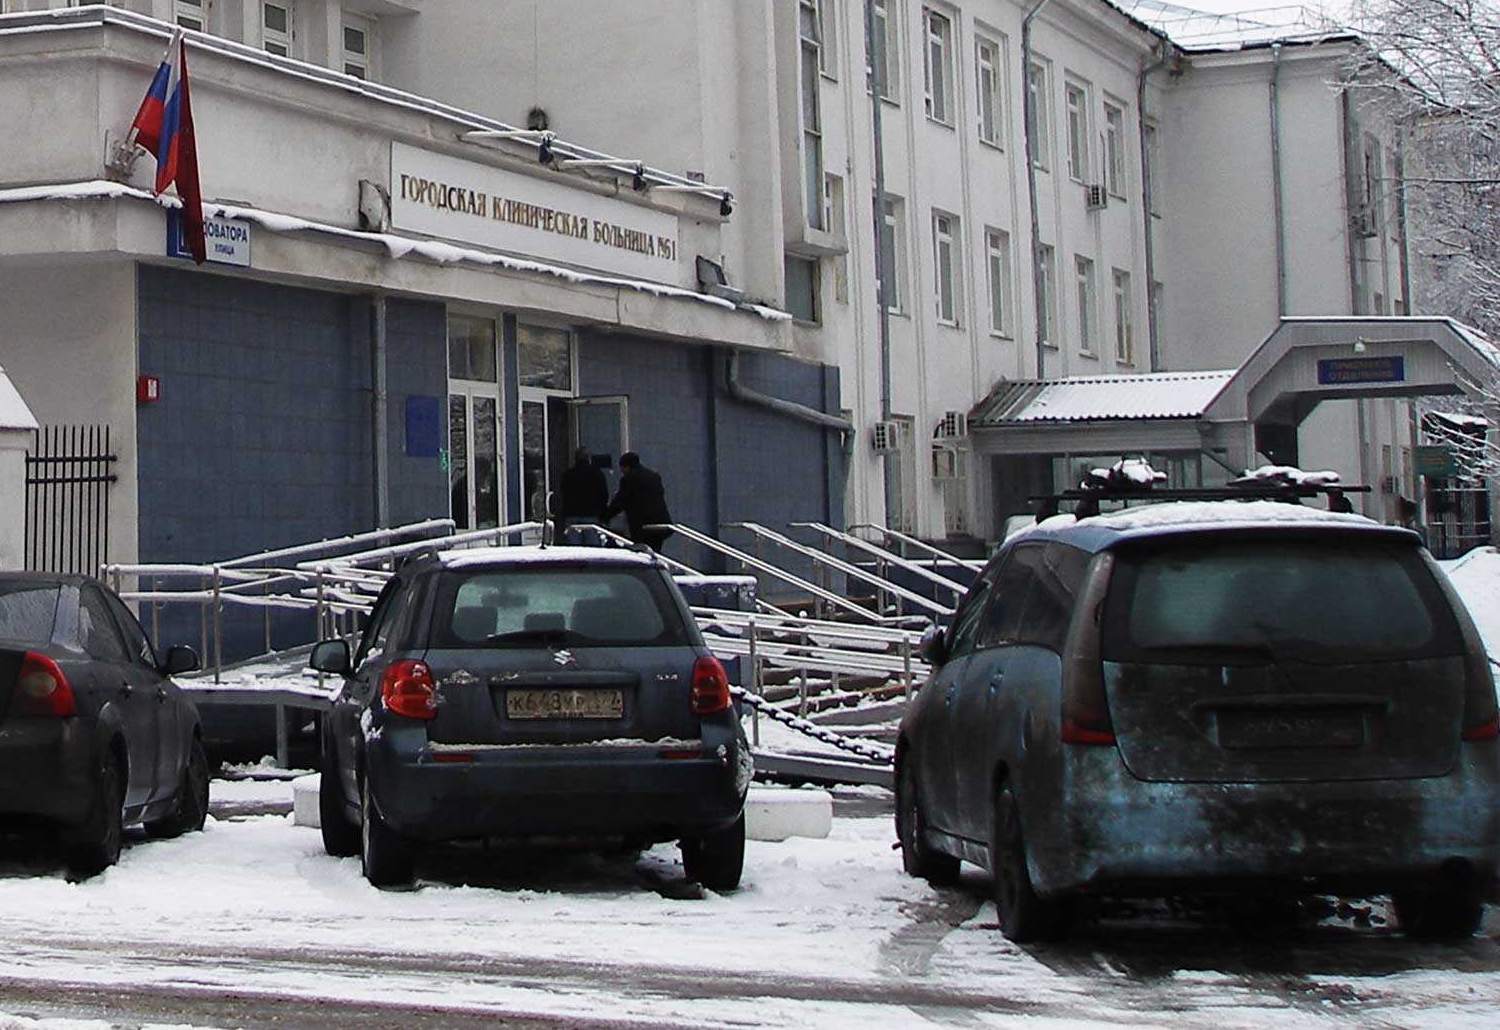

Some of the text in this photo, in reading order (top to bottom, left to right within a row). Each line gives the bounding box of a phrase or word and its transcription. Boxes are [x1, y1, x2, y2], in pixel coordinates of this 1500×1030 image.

[400, 173, 676, 261] ГОРОДСКАЯ КЛИНИЧЕСКАЯ БОЛЬНИЦА №61
